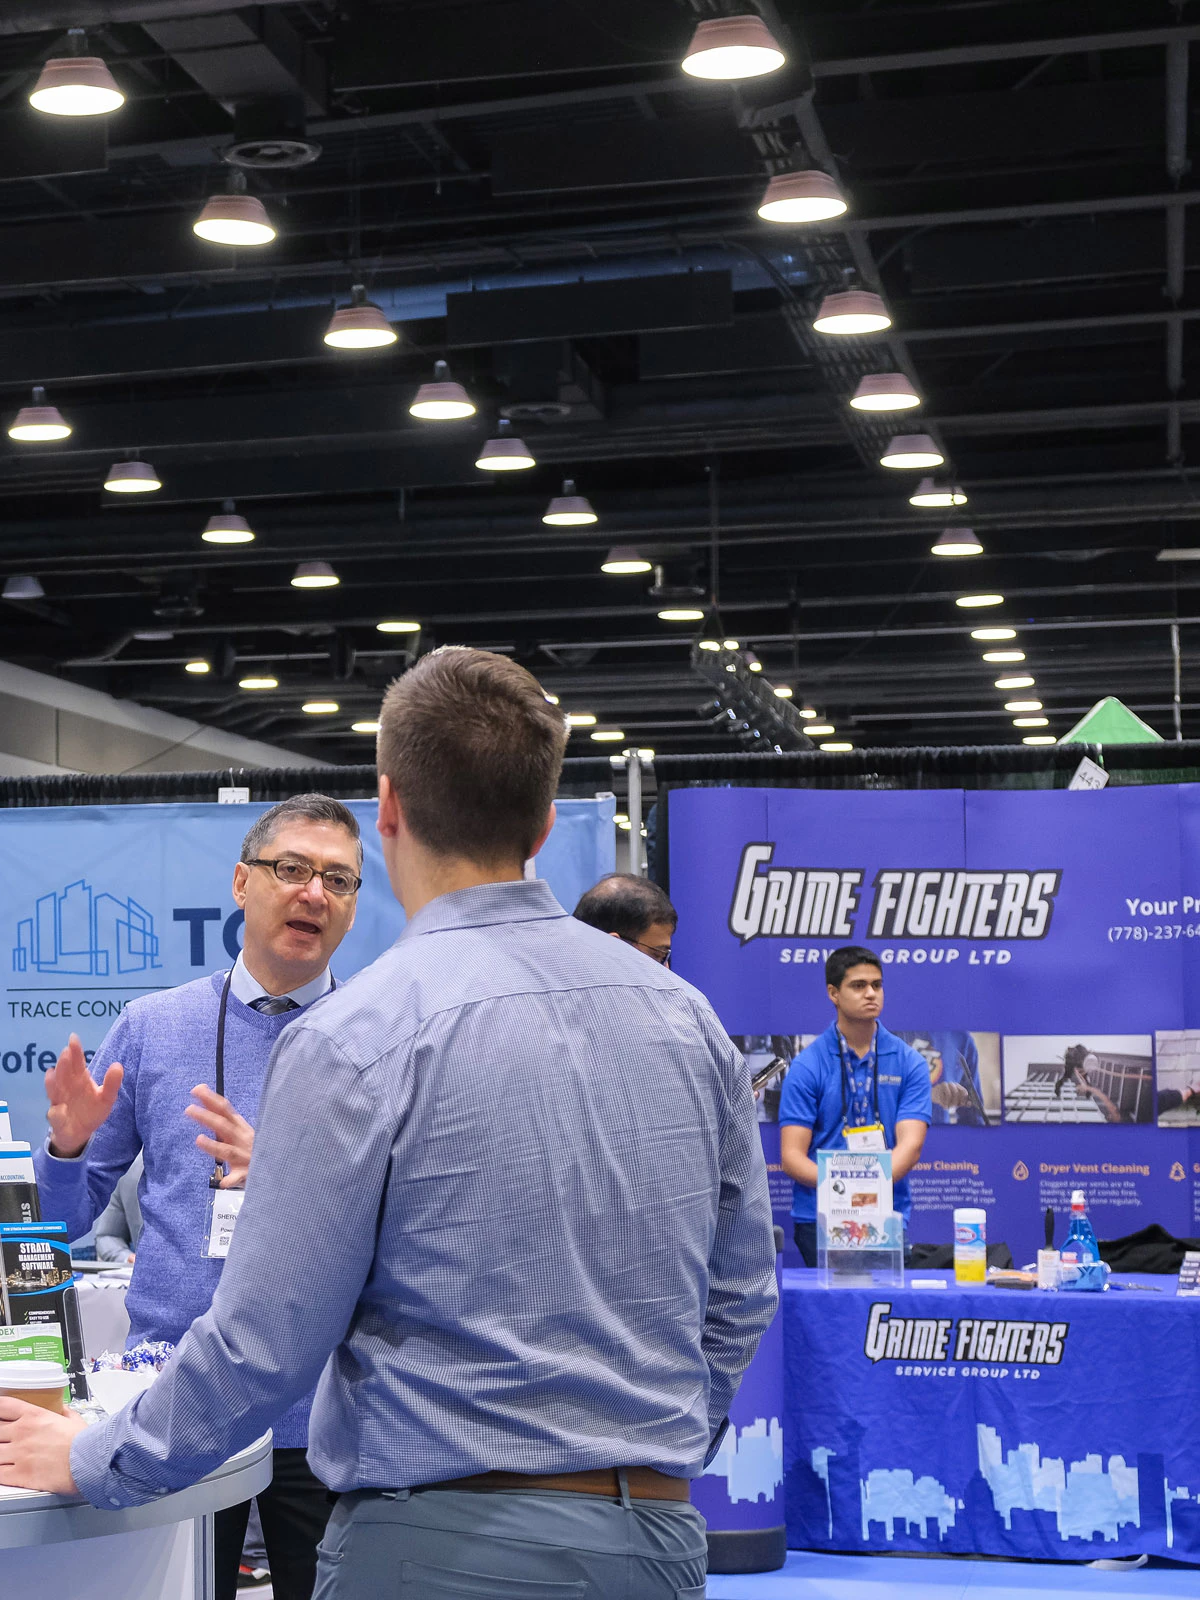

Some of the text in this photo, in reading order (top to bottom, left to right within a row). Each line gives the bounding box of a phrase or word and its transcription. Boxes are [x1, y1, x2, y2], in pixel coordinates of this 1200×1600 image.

[730, 844, 1059, 942] GRIME FIGHTERS
[1125, 898, 1179, 916] Your
[780, 949, 1012, 965] SERV GROUP LTD
[8, 1001, 72, 1018] TRACE
[831, 1170, 879, 1179] PRIZES
[934, 1160, 980, 1175] Cleaning
[1040, 1163, 1150, 1176] Dryer Vent Cleaning
[20, 1242, 51, 1253] STRATA
[18, 1253, 55, 1262] MANAGEMENT
[865, 1303, 1069, 1364] GRIME FIGHTERS
[895, 1366, 1041, 1380] SERVICE GROUP LTD
